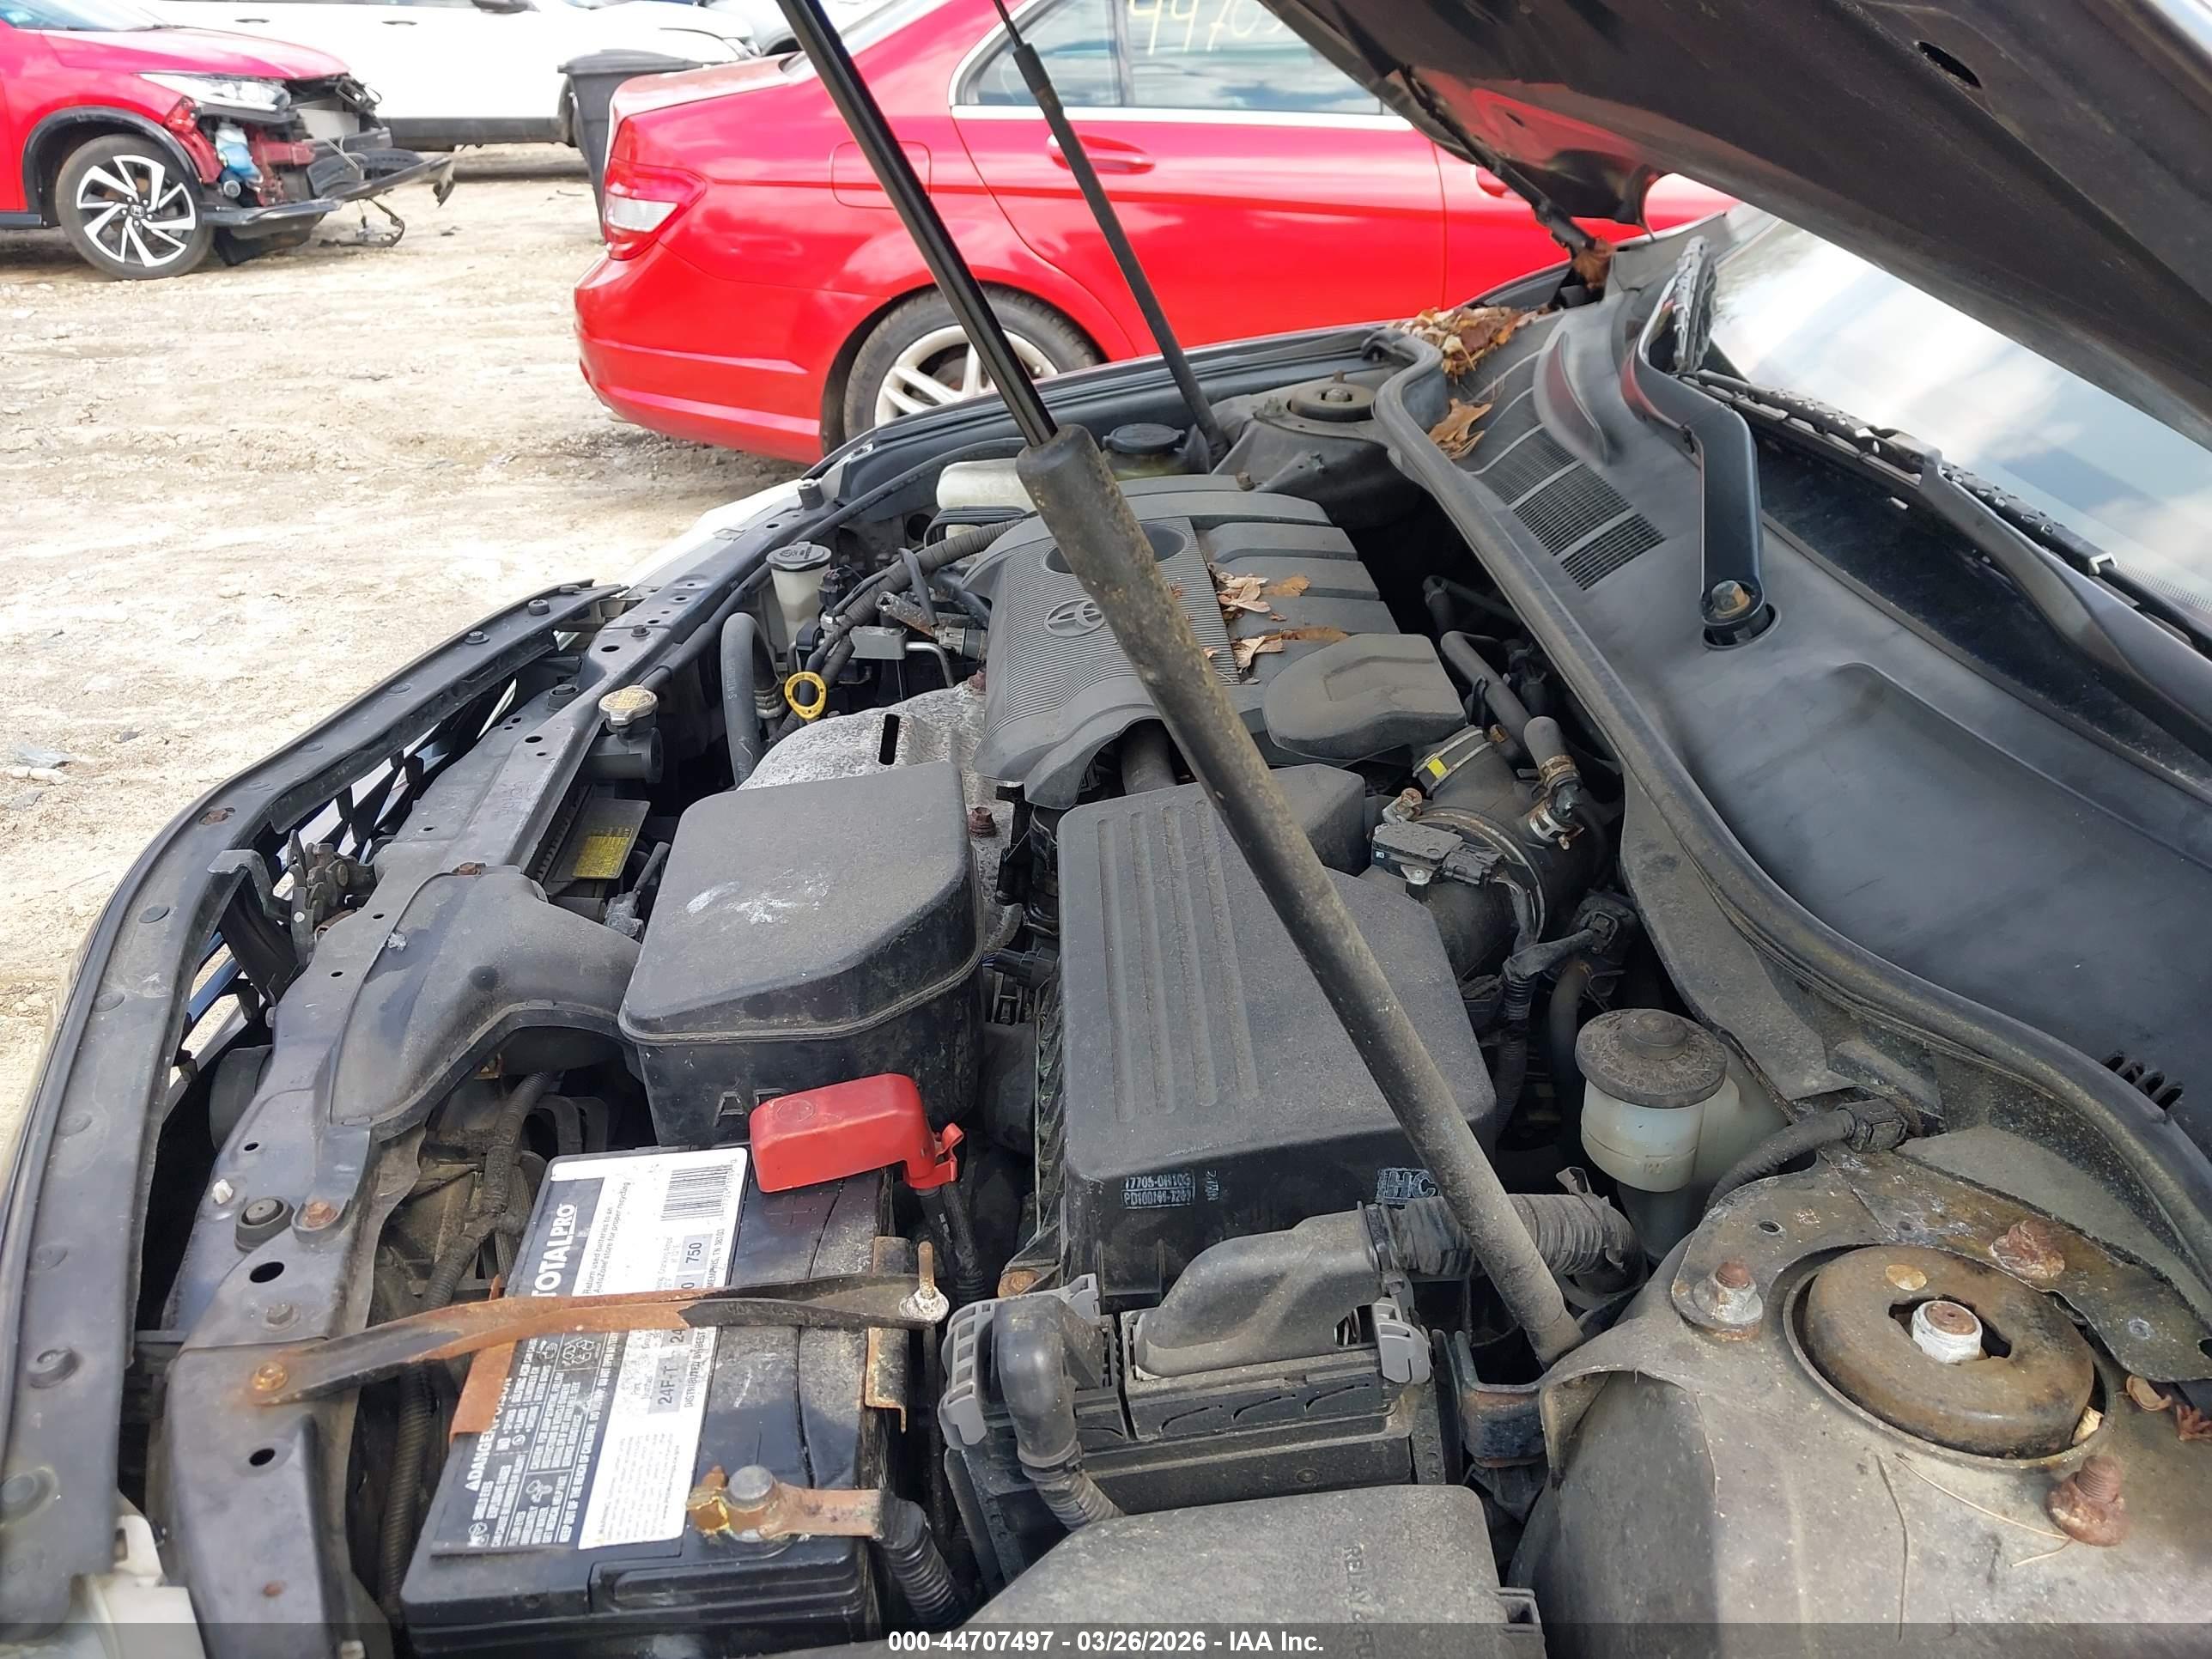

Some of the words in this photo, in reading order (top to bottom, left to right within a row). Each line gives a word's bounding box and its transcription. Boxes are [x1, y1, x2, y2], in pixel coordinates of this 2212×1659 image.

[589, 1252, 601, 1268] used
[602, 1243, 613, 1259] store
[684, 1242, 702, 1263] 750
[656, 1364, 679, 1404] 24F-T
